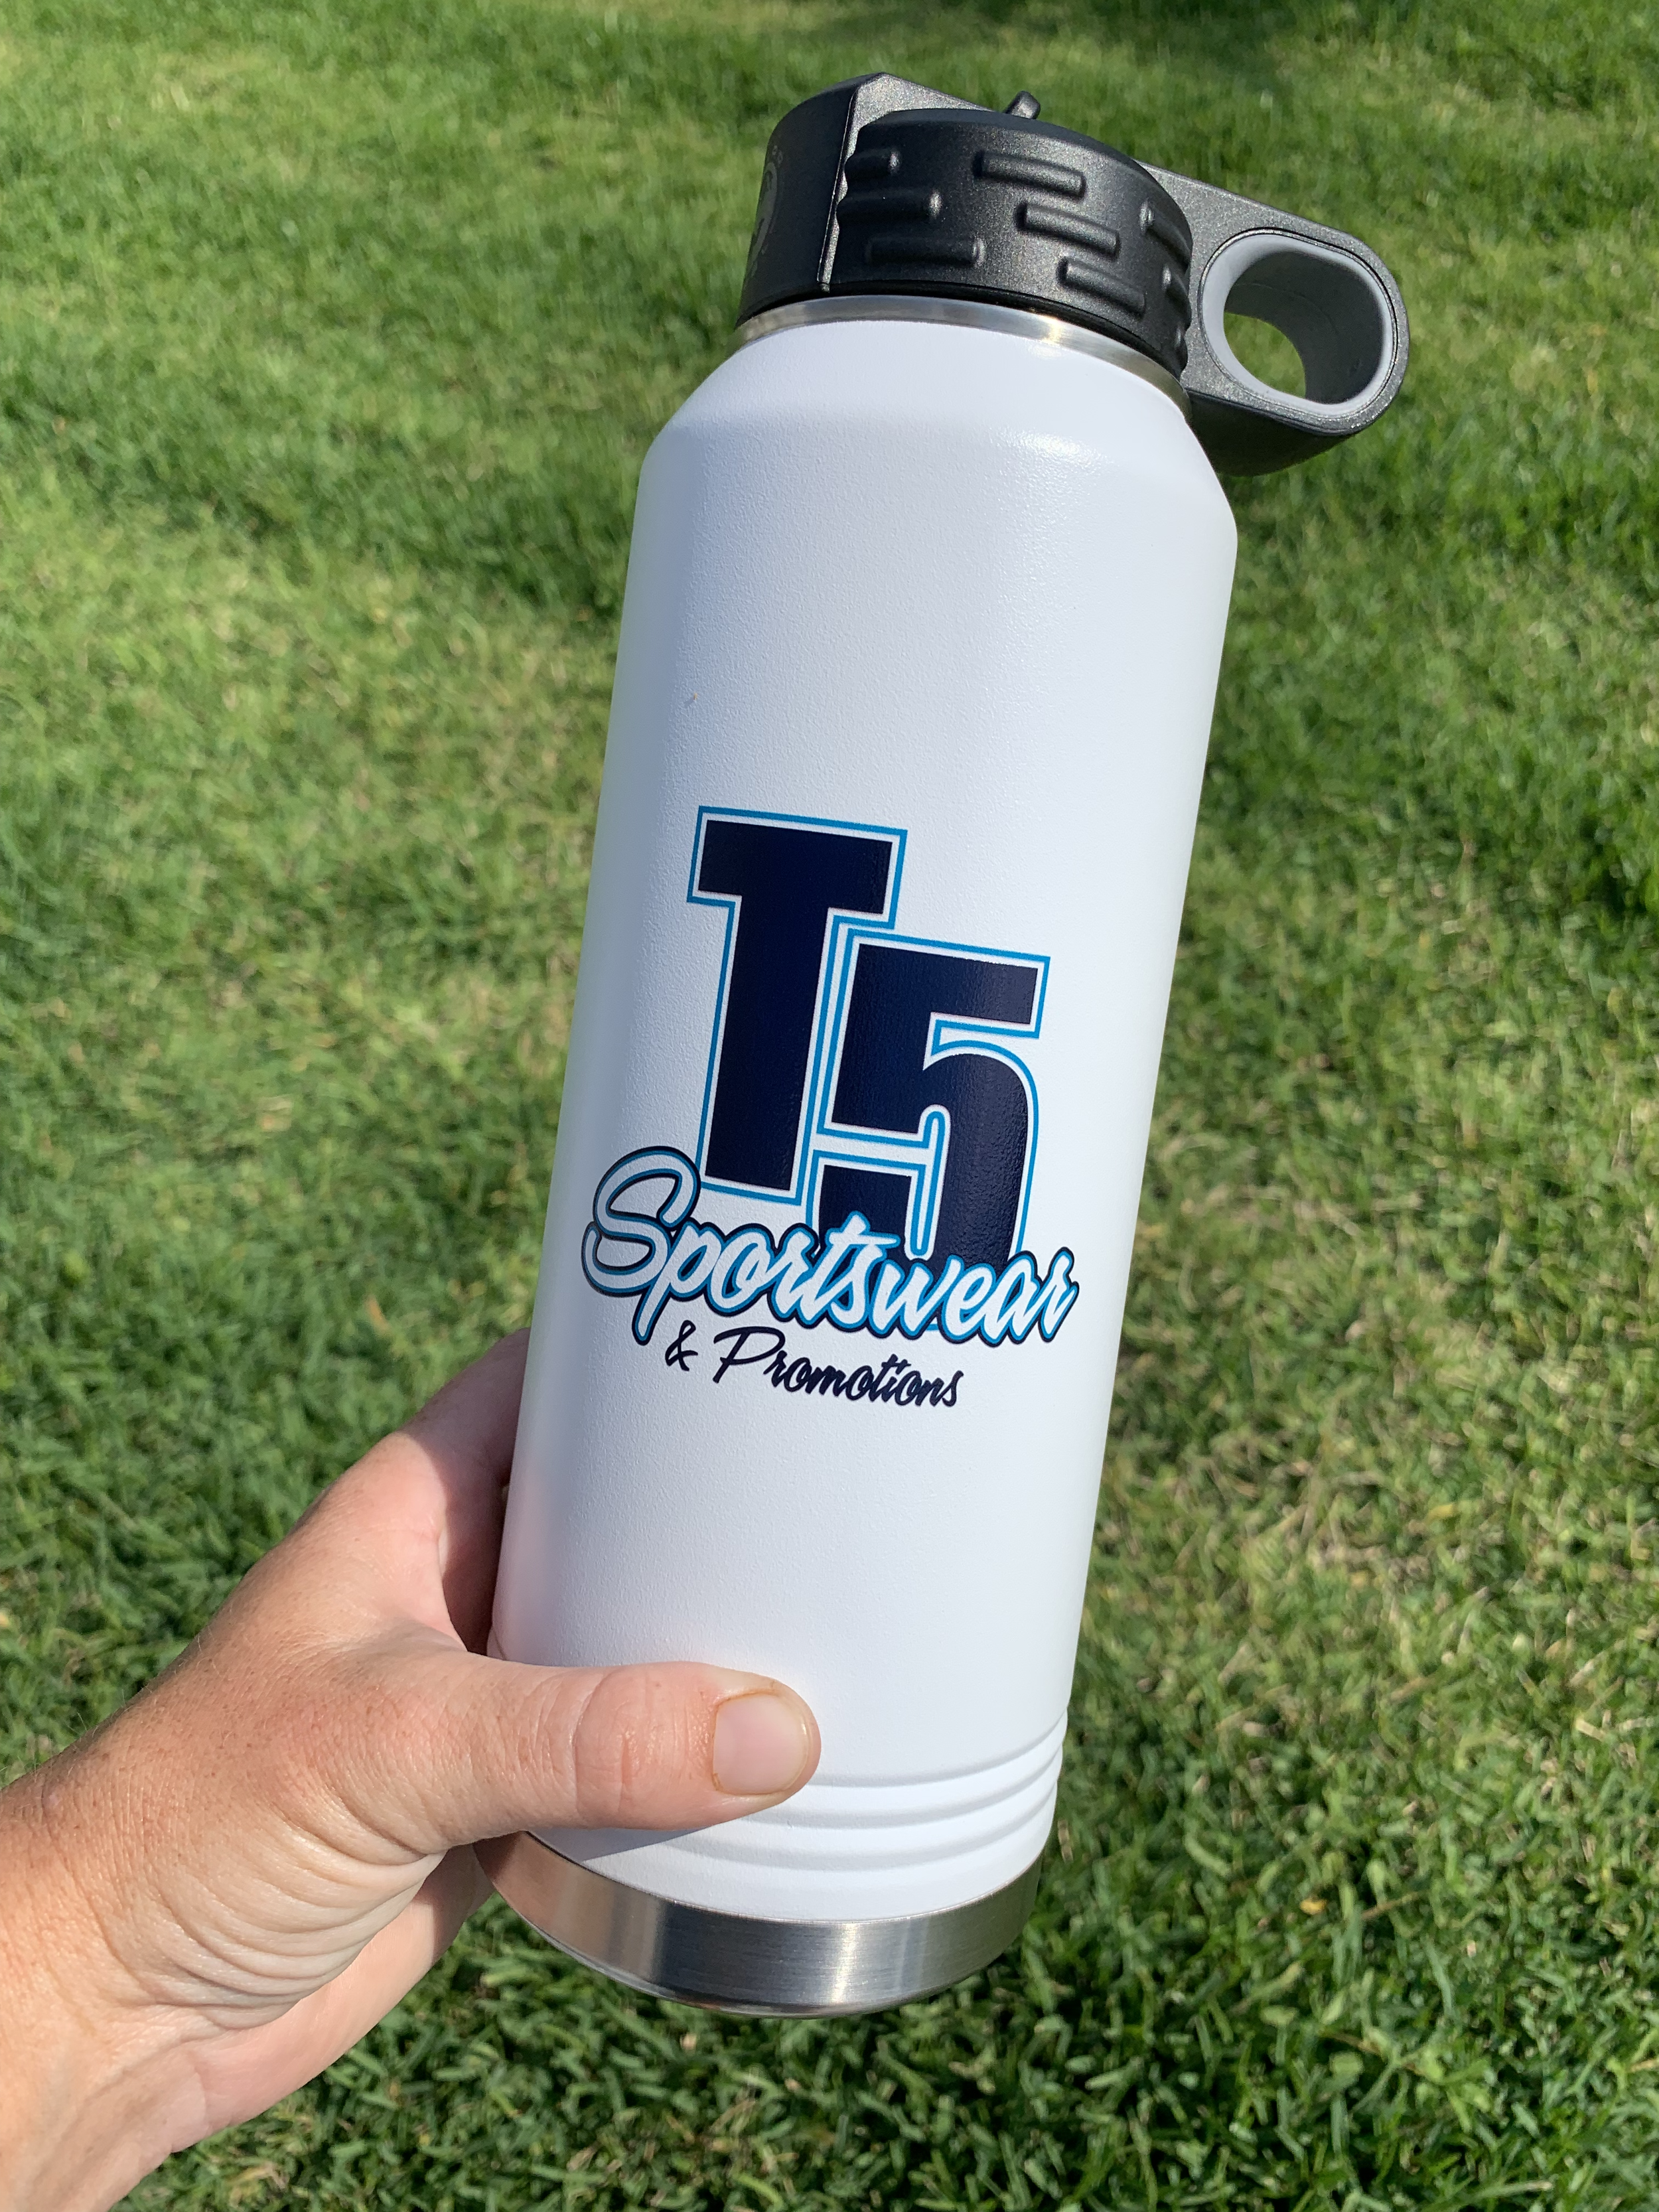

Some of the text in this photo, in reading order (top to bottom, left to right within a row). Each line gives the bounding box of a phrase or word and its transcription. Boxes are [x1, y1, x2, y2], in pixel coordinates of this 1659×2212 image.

[687, 806, 1050, 1294] T5
[581, 1146, 1080, 1346] Sportswear
[664, 1320, 965, 1408] & Promotions
